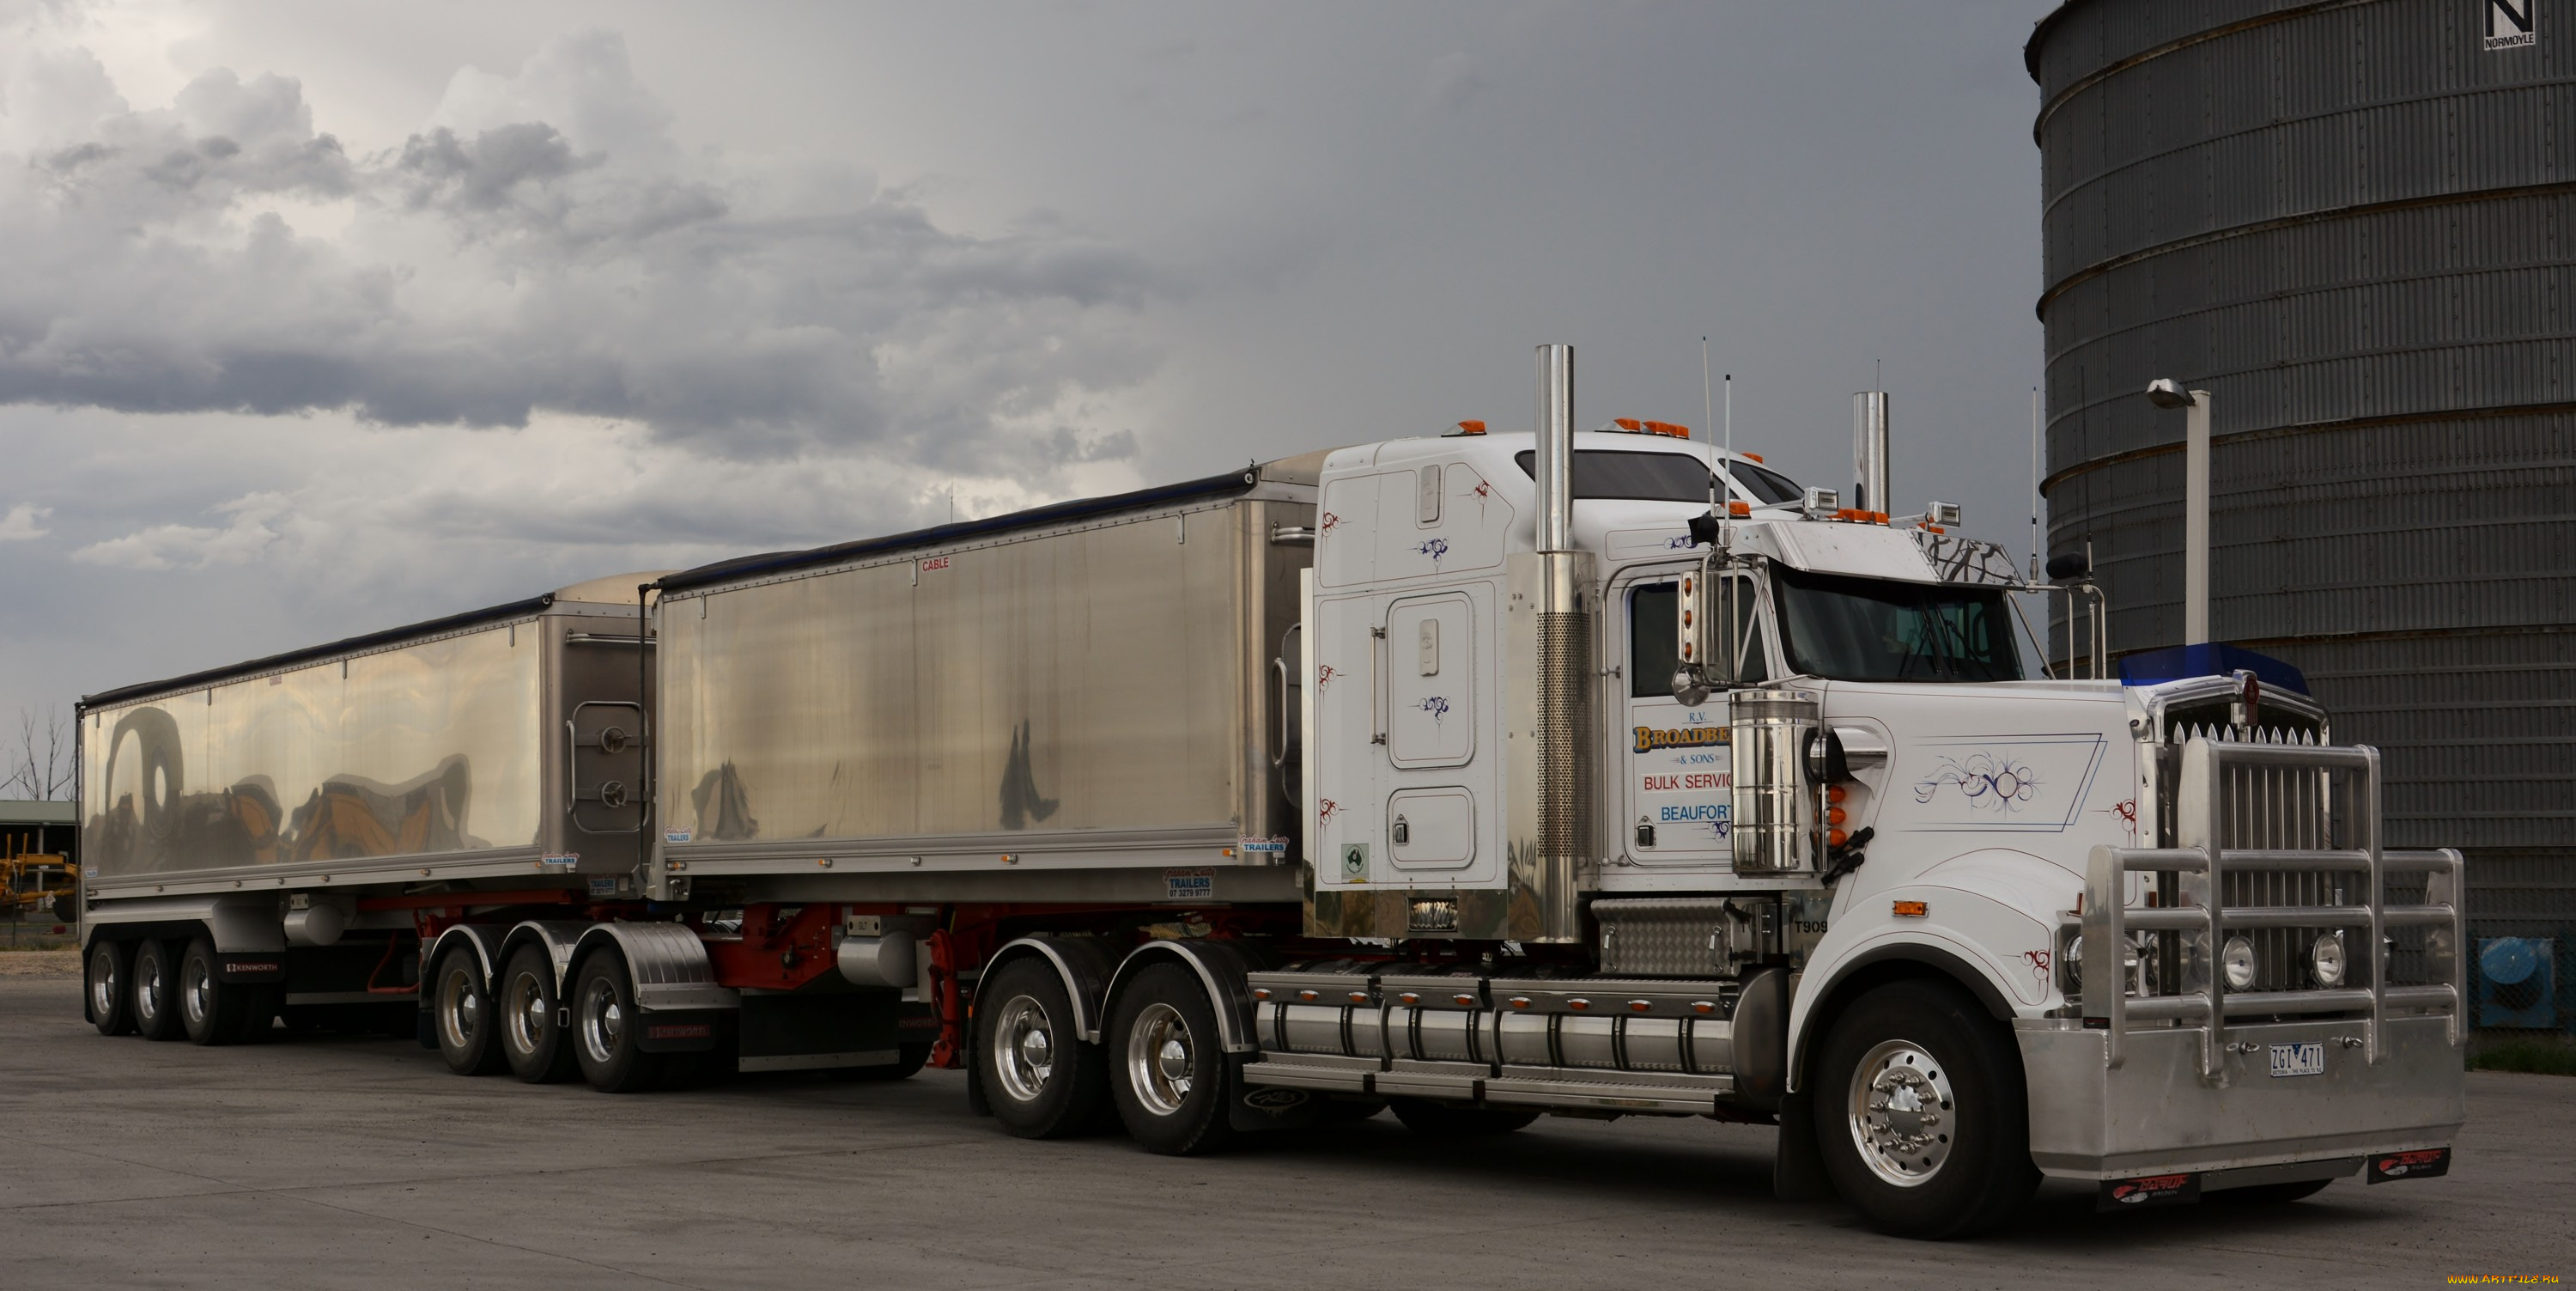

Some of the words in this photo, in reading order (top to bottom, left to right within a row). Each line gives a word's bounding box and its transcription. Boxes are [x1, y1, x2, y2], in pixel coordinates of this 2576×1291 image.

[2485, 0, 2533, 37] N
[2485, 34, 2534, 48] NORMOYLE
[922, 557, 948, 571] CABLE
[1689, 712, 1707, 722] R.V.
[1680, 755, 1687, 764] &
[1690, 754, 1715, 764] SONS
[1644, 776, 1680, 790] BULK
[1239, 834, 1267, 846] Graham
[1269, 834, 1289, 845] Lusty
[1163, 867, 1192, 881] Graham
[1170, 878, 1210, 888] TRAILERS
[1795, 921, 1828, 933] T909
[2272, 1049, 2291, 1069] ZGI
[2301, 1047, 2320, 1067] 471
